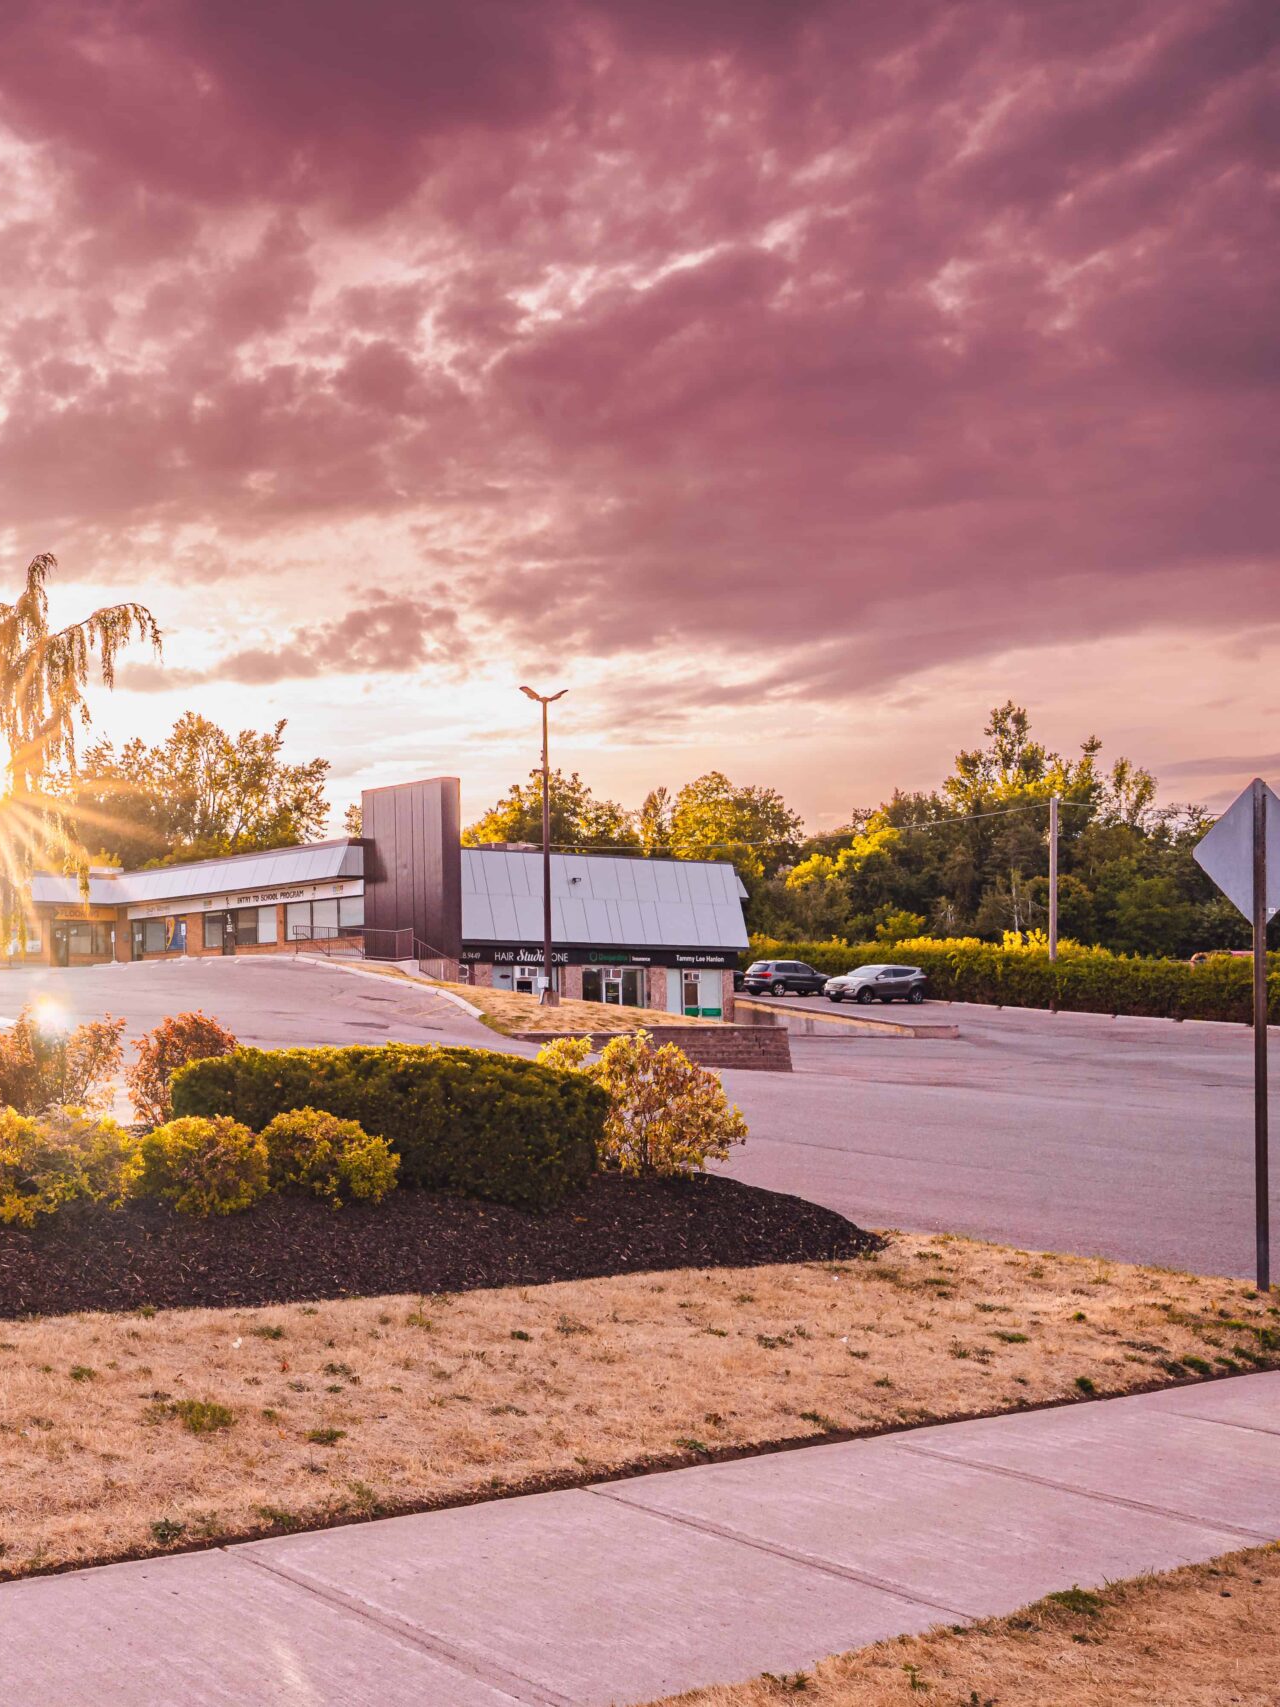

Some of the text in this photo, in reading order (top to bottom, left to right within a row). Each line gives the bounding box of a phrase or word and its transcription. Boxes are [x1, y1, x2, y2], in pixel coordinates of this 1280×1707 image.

[260, 893, 278, 902] SCHOOL
[280, 890, 304, 900] PROGRAM
[494, 951, 514, 961] HAIR
[551, 952, 569, 962] ONE
[675, 954, 695, 963] Tammy
[706, 955, 725, 963] Hanlon
